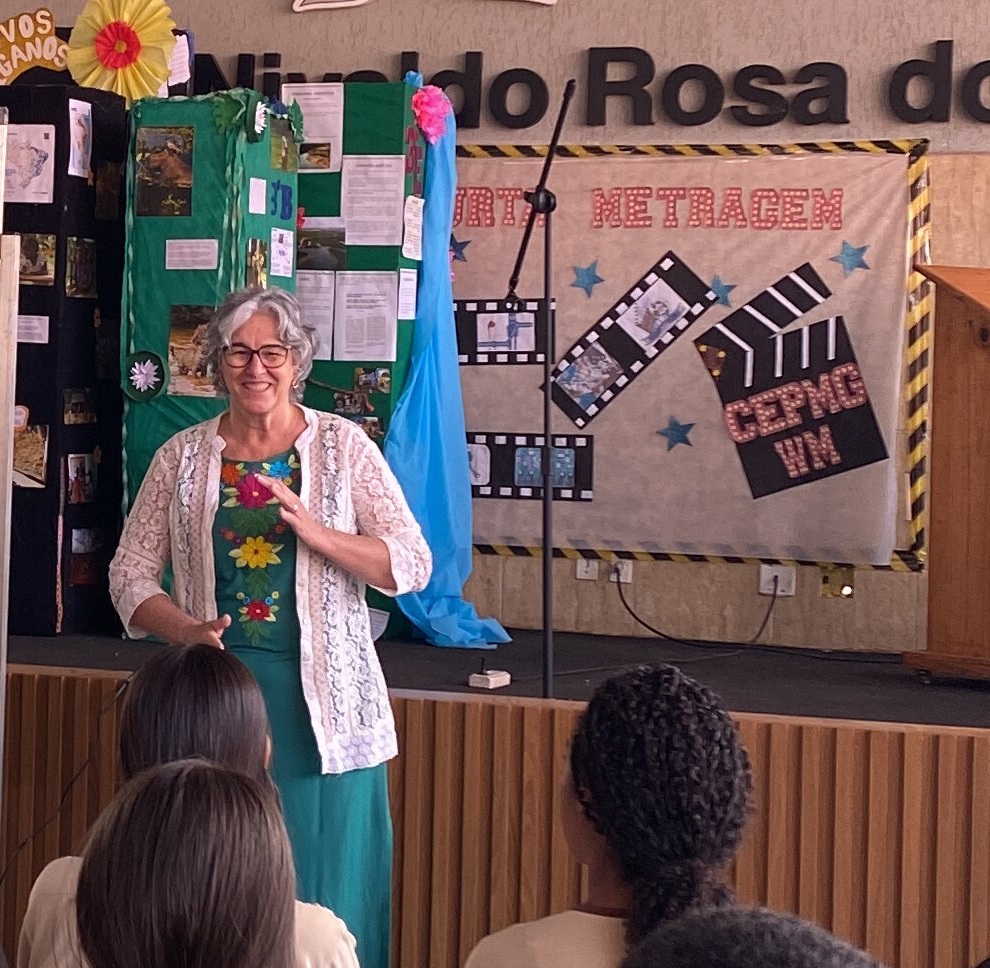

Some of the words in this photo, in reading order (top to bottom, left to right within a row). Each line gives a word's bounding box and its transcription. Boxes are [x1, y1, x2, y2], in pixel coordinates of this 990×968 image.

[585, 46, 850, 126] Rosa
[592, 186, 844, 230] METRAGEM
[724, 362, 867, 444] CEPMG
